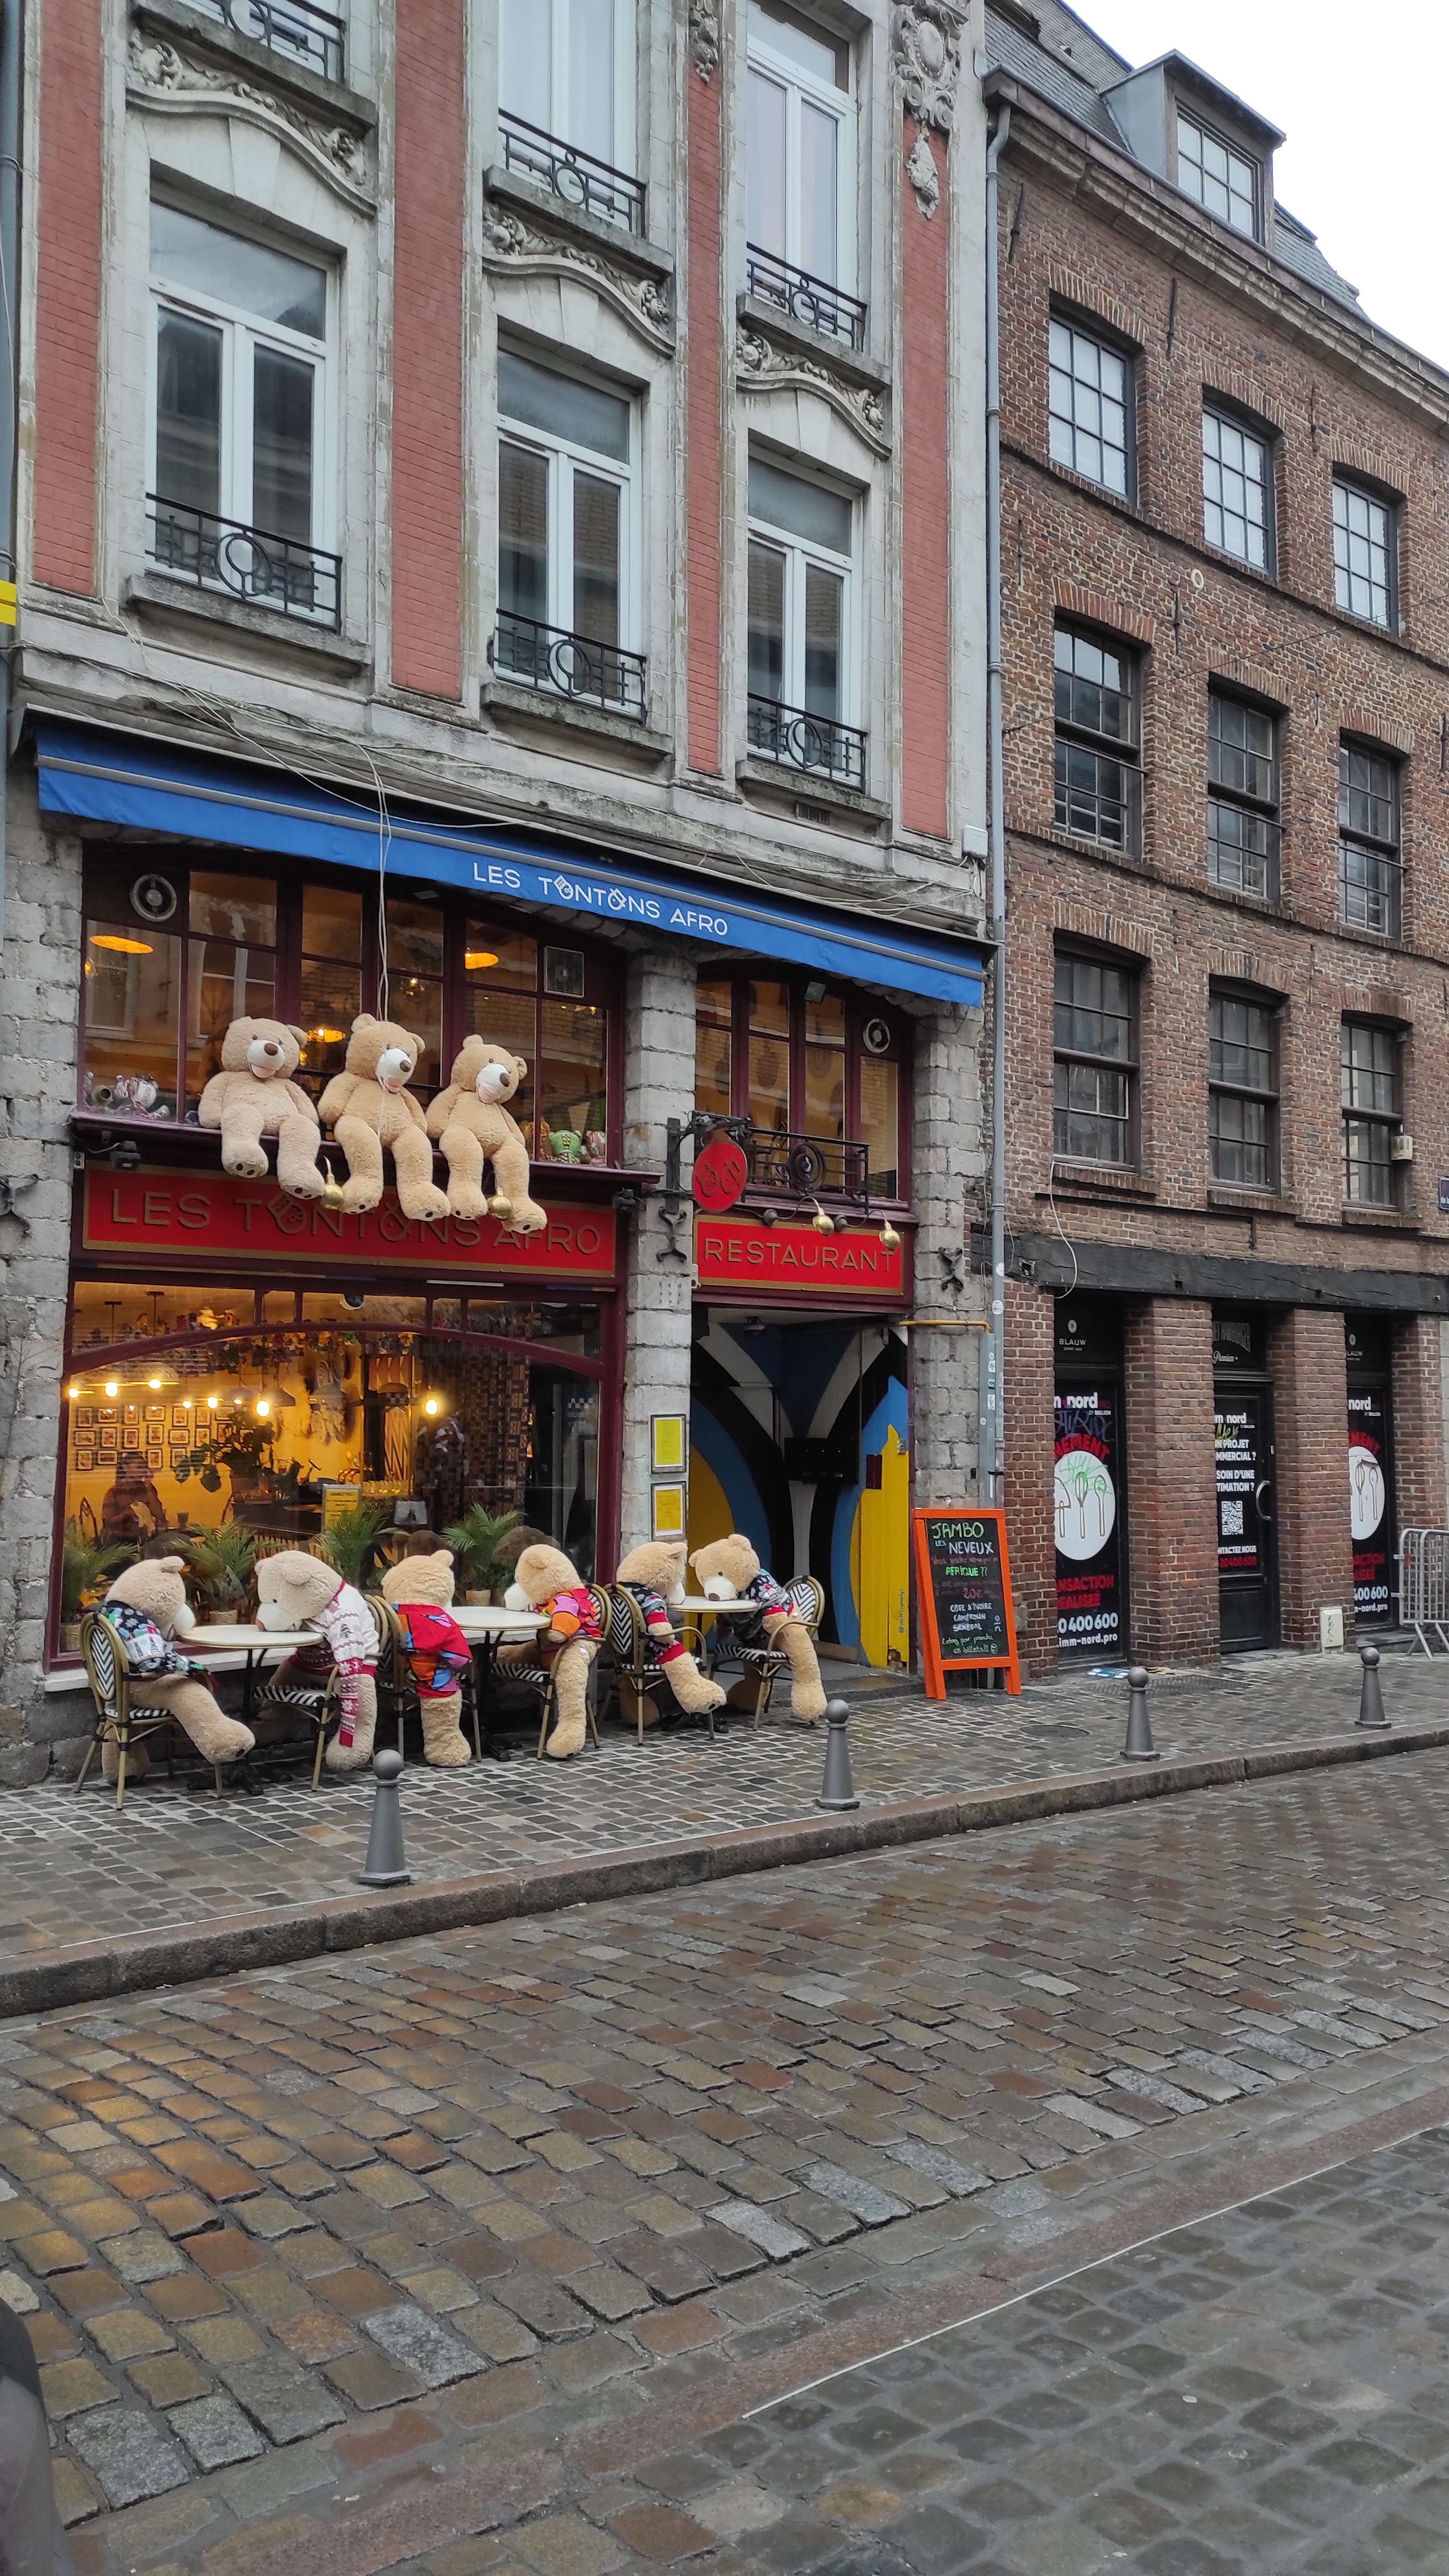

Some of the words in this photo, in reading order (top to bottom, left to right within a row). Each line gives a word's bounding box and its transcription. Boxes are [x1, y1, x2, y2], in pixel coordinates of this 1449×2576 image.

[473, 862, 521, 888] LES
[538, 874, 661, 919] TONTONS
[670, 907, 728, 936] AFRO
[113, 1189, 211, 1229] LES
[705, 1238, 895, 1272] RESTAURANT
[1066, 1392, 1099, 1409] nord
[1348, 1396, 1372, 1411] nord
[1226, 1412, 1247, 1423] nord
[1222, 1439, 1250, 1448] PROJET
[1216, 1451, 1251, 1461] MMERCIAL
[1216, 1470, 1234, 1480] SOIN
[1234, 1470, 1255, 1479] D'UNE
[1215, 1482, 1250, 1492] TIMATION
[931, 1521, 984, 1539] JAMBO
[948, 1541, 994, 1555] NEVEUX
[1371, 1585, 1388, 1600] 600
[1056, 1618, 1067, 1634] 0
[1068, 1614, 1094, 1633] 400
[1094, 1612, 1119, 1630] 600
